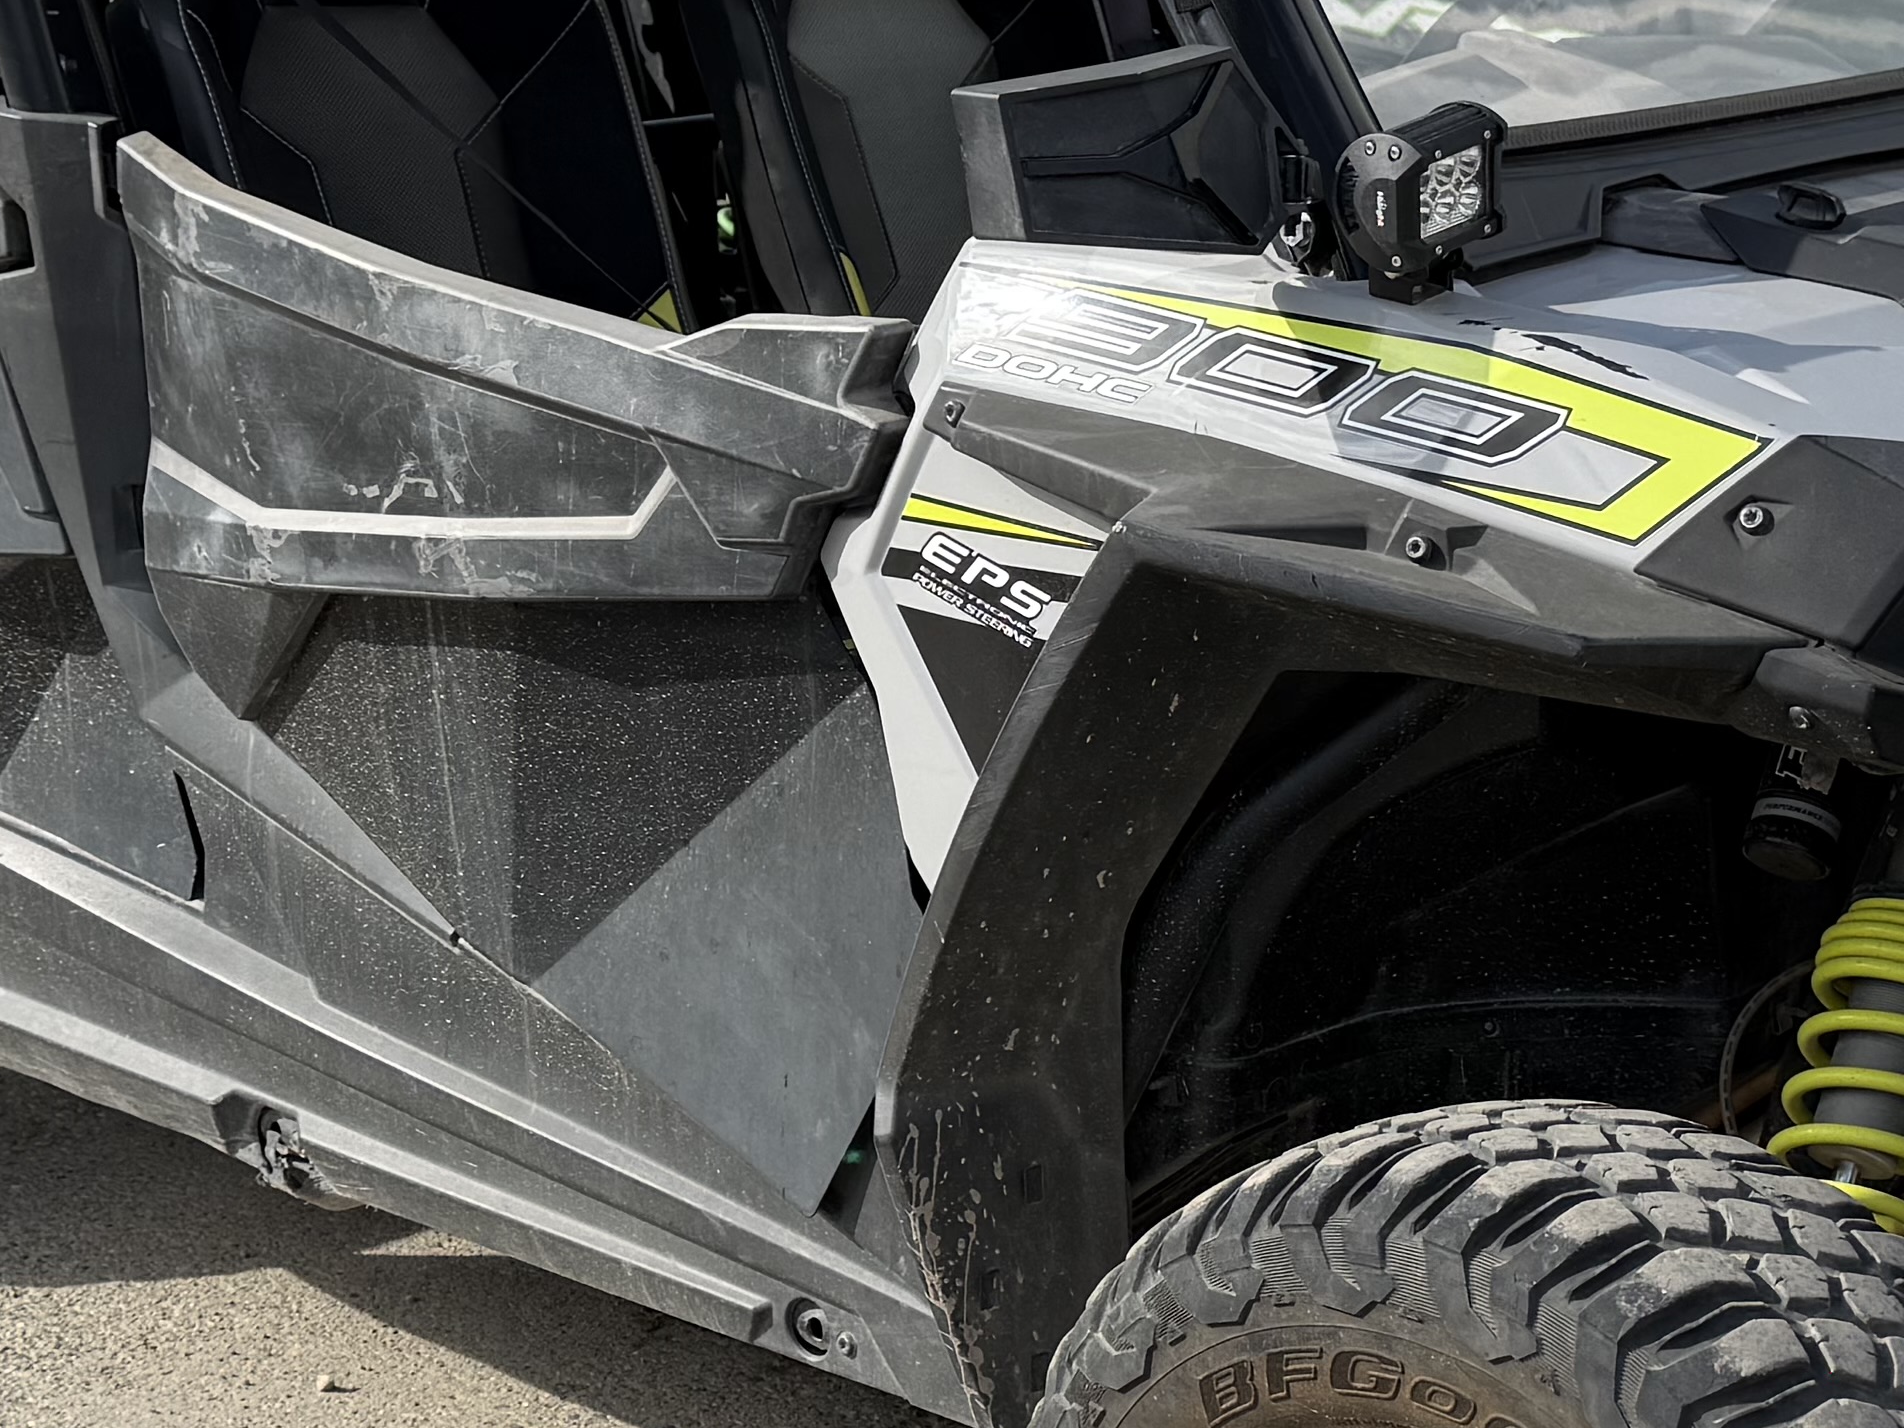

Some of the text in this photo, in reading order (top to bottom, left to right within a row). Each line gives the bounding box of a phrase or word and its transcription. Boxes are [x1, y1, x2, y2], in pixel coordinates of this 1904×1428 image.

[952, 341, 1154, 404] DOHC
[911, 572, 1035, 649] POWER STEERING
[919, 564, 1037, 636] ELECTRONIC
[920, 531, 1053, 621] EPS
